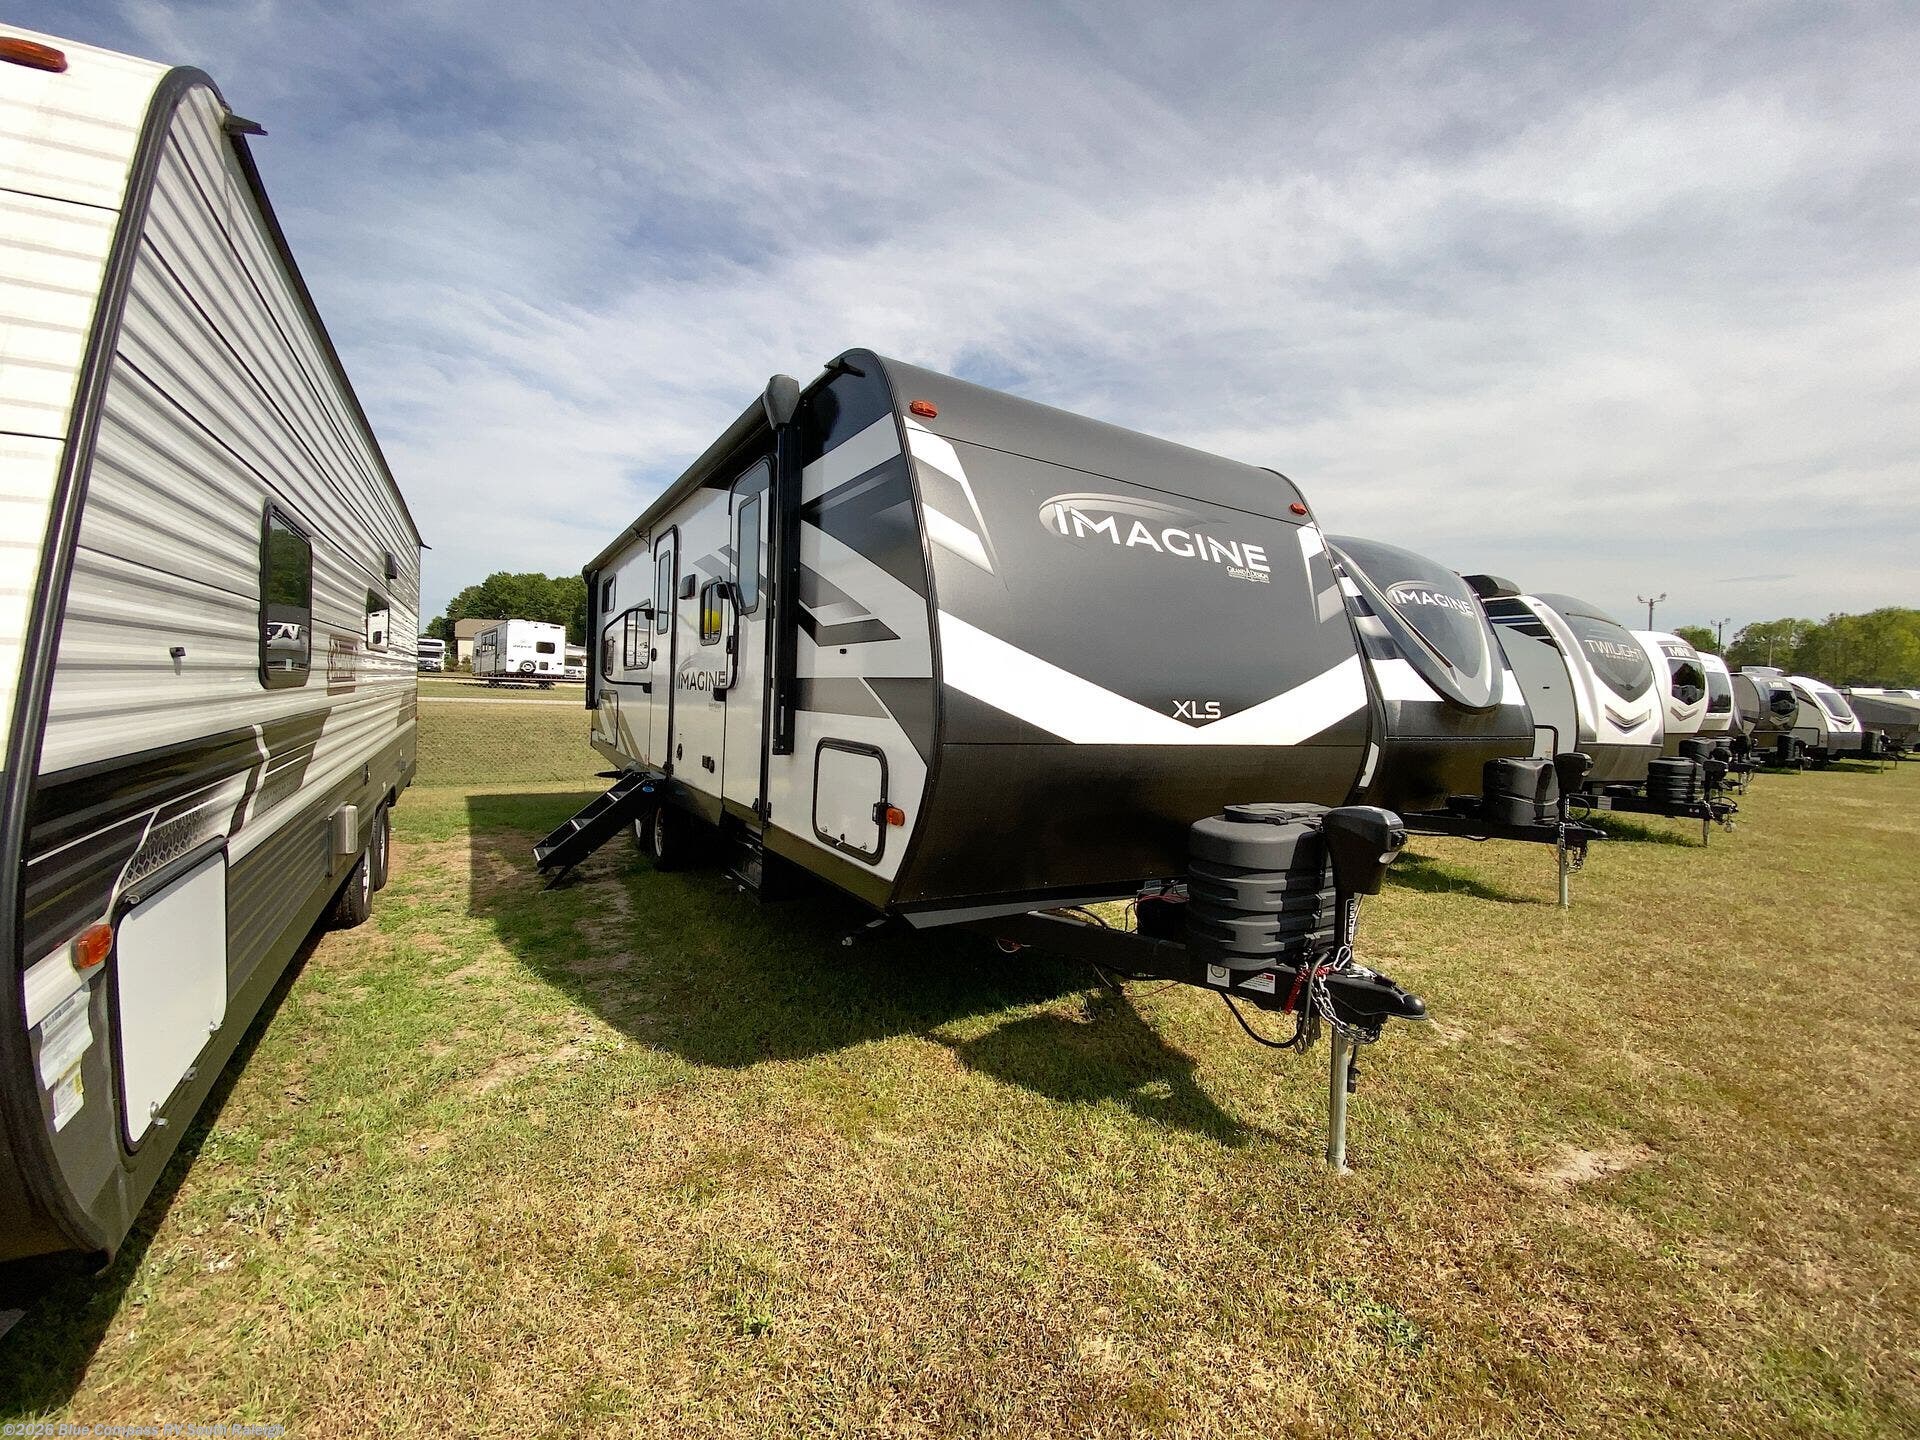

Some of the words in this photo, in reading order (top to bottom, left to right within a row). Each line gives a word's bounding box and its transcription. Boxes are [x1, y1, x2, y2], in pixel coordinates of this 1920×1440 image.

[1054, 503, 1271, 573] IMAGINE
[1391, 589, 1475, 616] IMAGINE
[1584, 639, 1642, 662] TWILIGHT
[677, 670, 727, 692] IMAGINE
[1172, 700, 1221, 719] XLS
